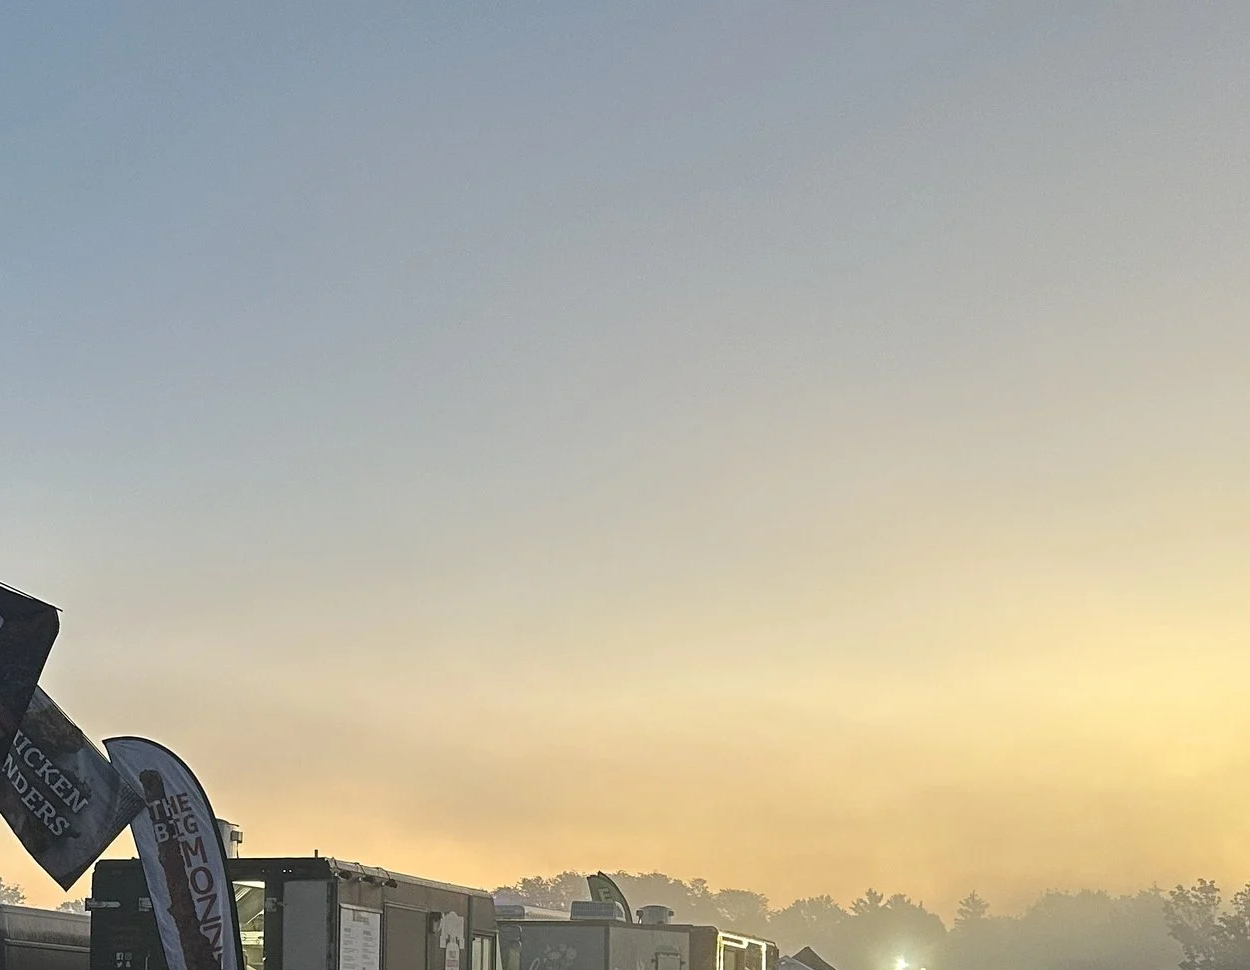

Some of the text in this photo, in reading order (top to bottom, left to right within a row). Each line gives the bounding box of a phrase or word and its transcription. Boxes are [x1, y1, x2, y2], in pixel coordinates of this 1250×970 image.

[1, 753, 71, 837] NDERS
[150, 792, 193, 820] THE
[154, 814, 199, 843] BIG
